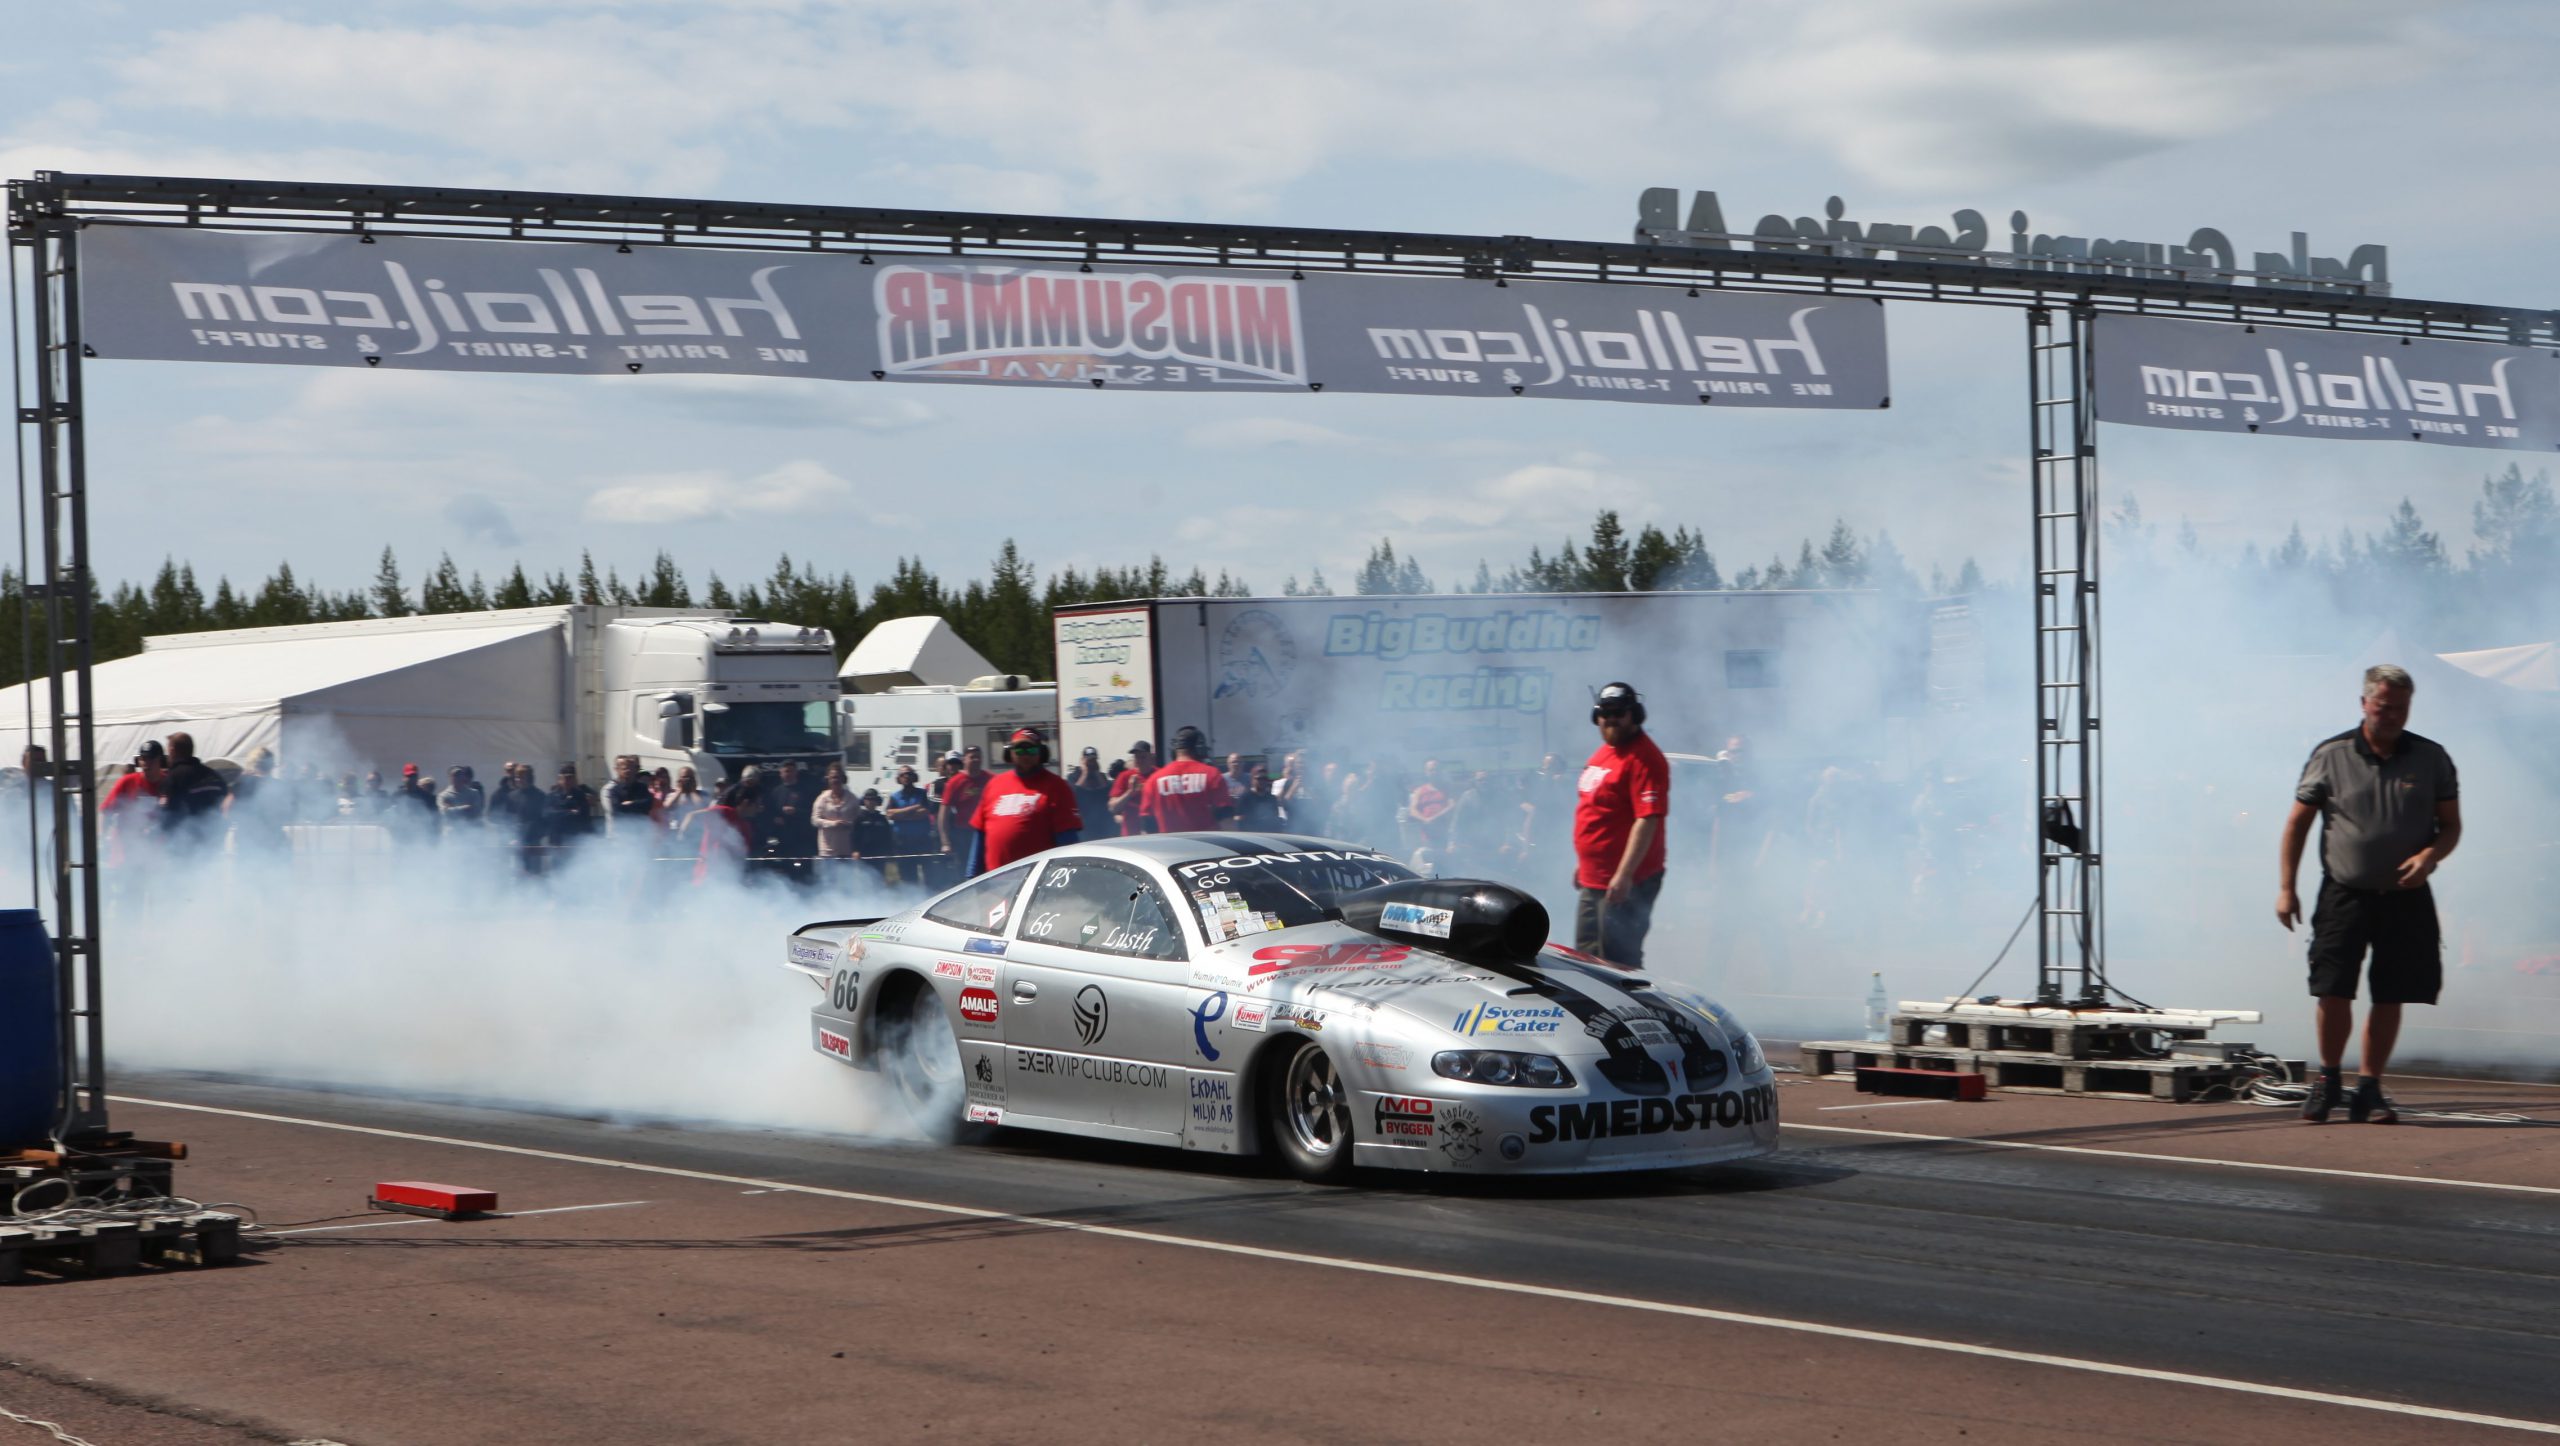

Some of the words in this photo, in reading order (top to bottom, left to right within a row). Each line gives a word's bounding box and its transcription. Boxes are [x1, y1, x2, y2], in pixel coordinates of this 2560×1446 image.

[1324, 610, 1600, 661] BigBuddha
[1380, 665, 1552, 714] Racing
[1178, 851, 1408, 878] PONTIAC
[1046, 868, 1077, 888] PS
[1199, 872, 1231, 888] 66
[1030, 913, 1060, 936] 66
[1103, 927, 1158, 951] Lusth
[935, 962, 963, 977] SIMPSON
[1248, 944, 1412, 975] SVB
[833, 969, 859, 1013] 66
[961, 996, 998, 1012] AMALIE
[1275, 1004, 1328, 1022] DIAMOND
[1485, 1006, 1565, 1018] Svensk
[1498, 1019, 1560, 1032] Cater
[1190, 1077, 1231, 1100] EKDAHL
[1193, 1101, 1216, 1123] MILJÖ
[1220, 1104, 1232, 1122] AB
[1385, 1097, 1432, 1114] MO
[1386, 1121, 1433, 1136] BYGGEN
